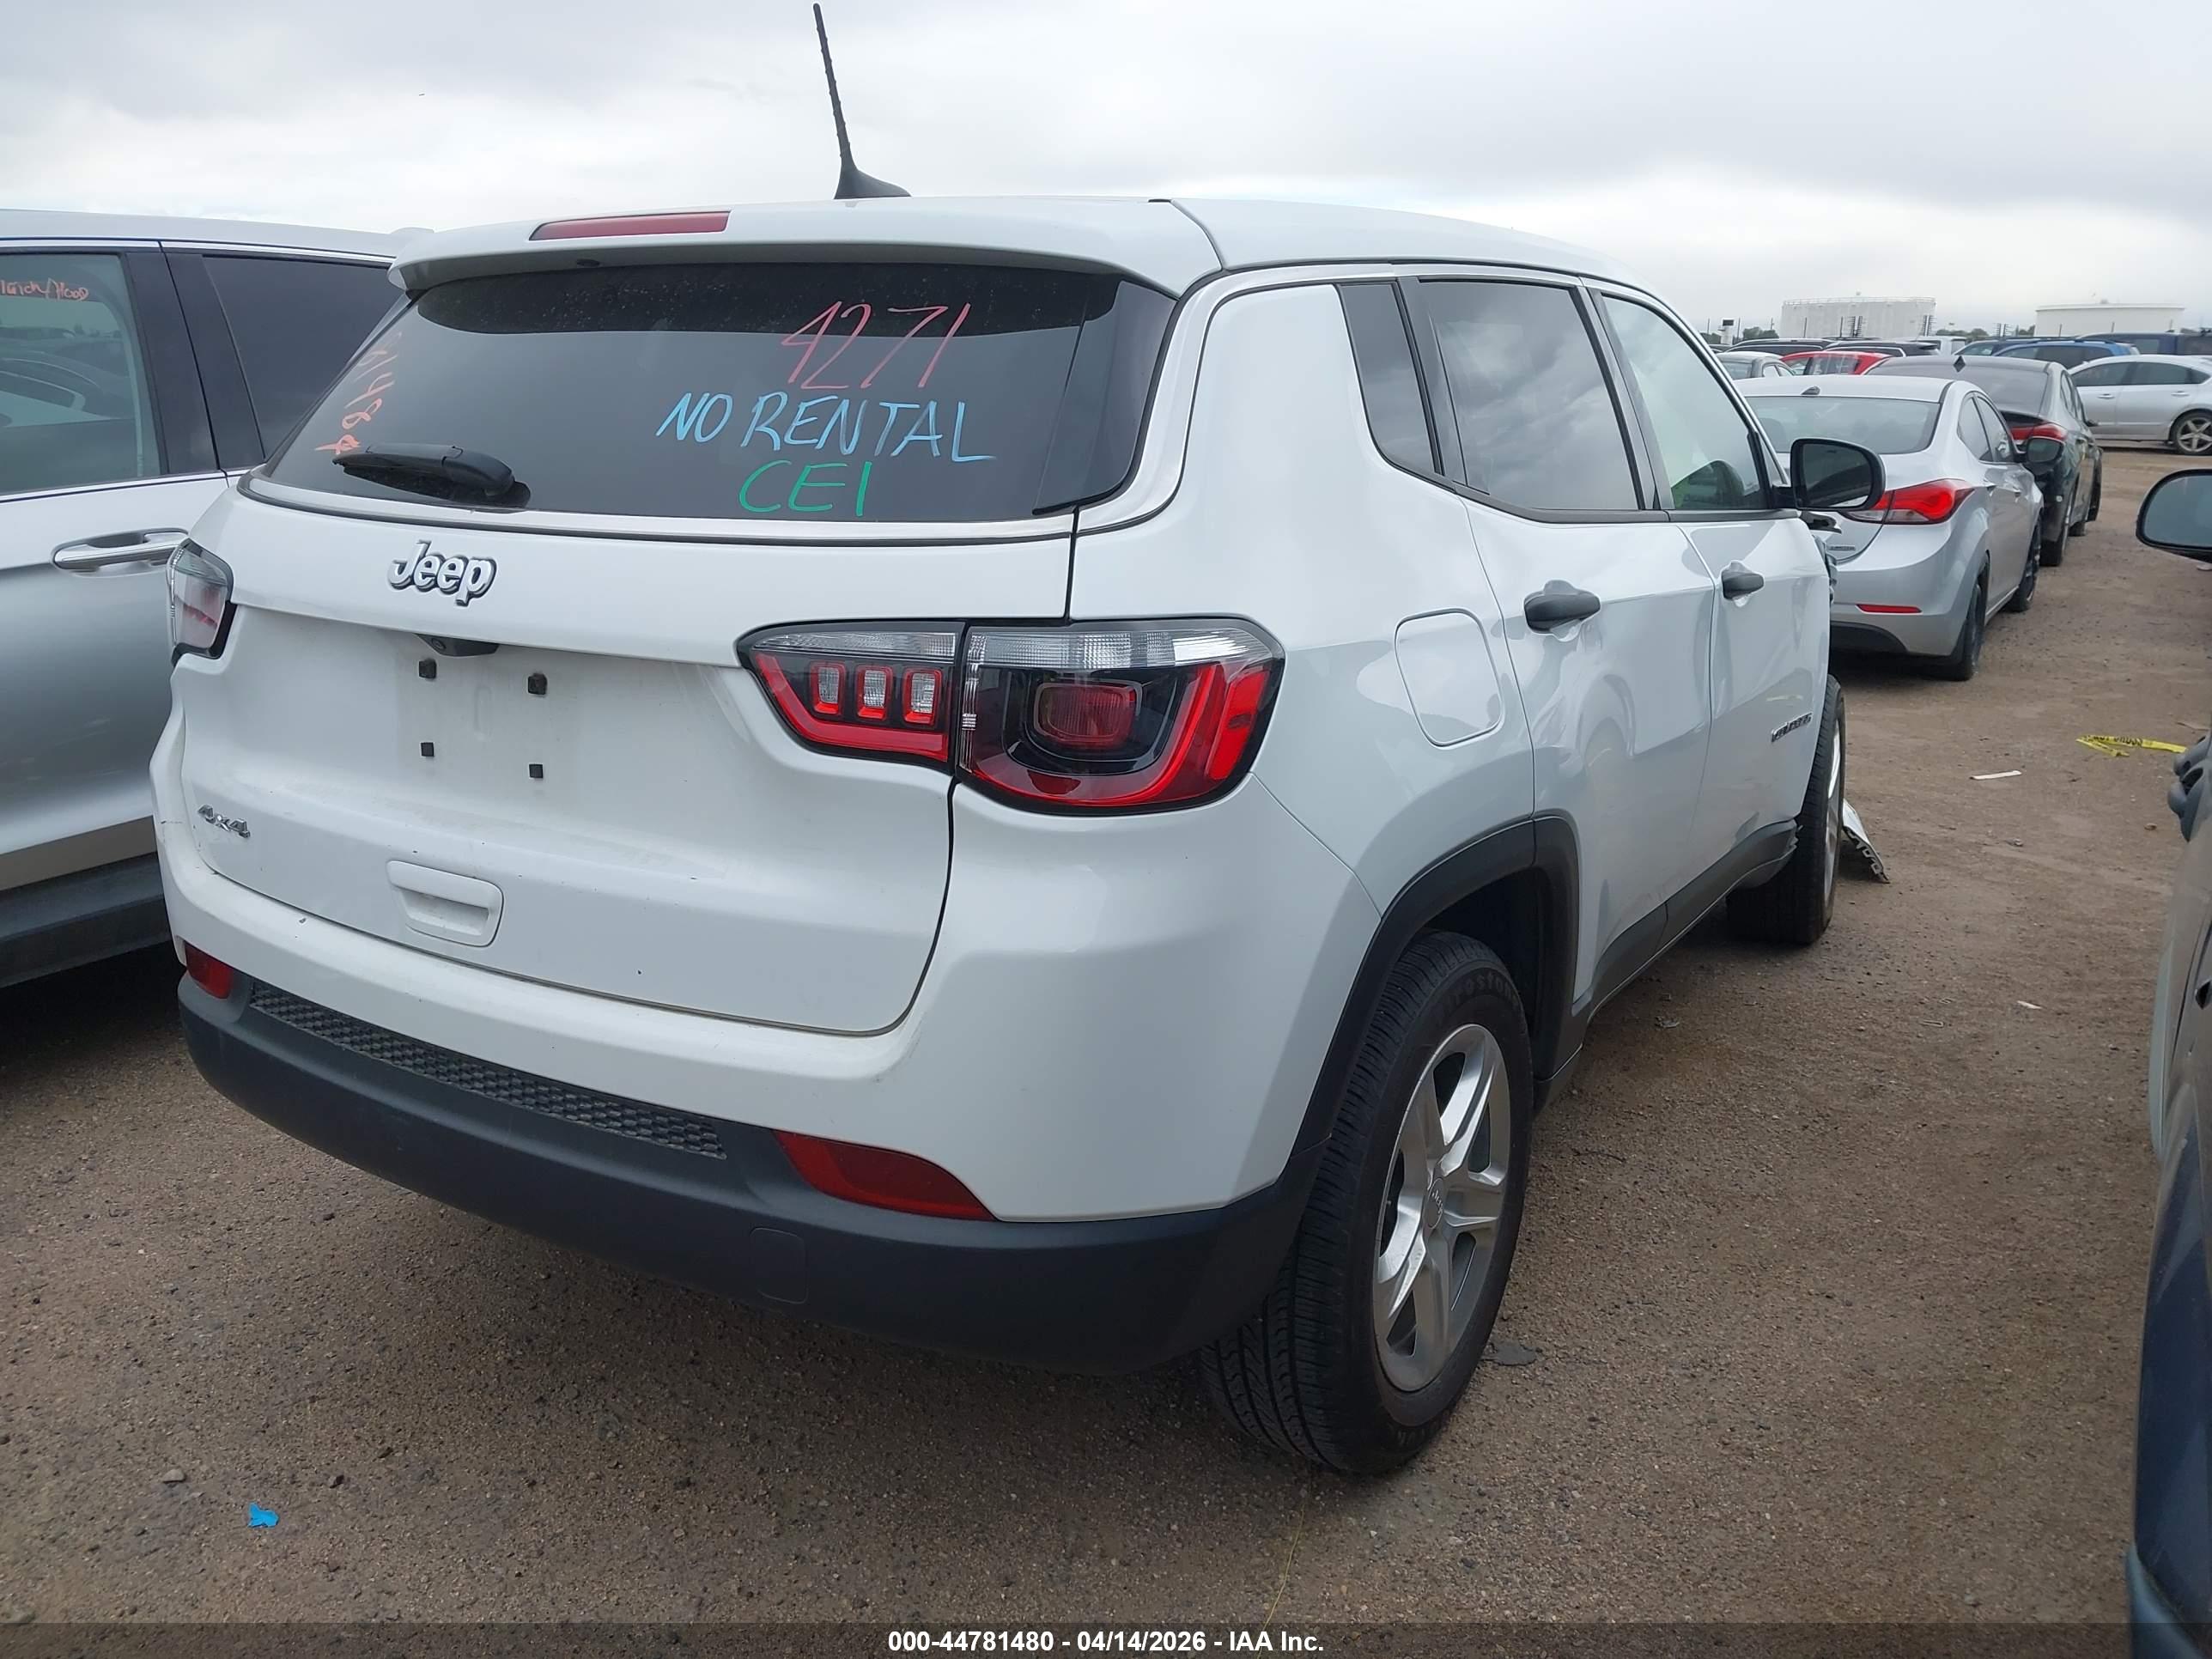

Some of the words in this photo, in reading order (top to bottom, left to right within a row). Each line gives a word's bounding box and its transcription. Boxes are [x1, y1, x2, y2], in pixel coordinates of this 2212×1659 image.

[781, 301, 971, 389] 4271
[656, 391, 732, 444] NO
[740, 391, 997, 463] RENTAL
[386, 539, 498, 608] Jeep
